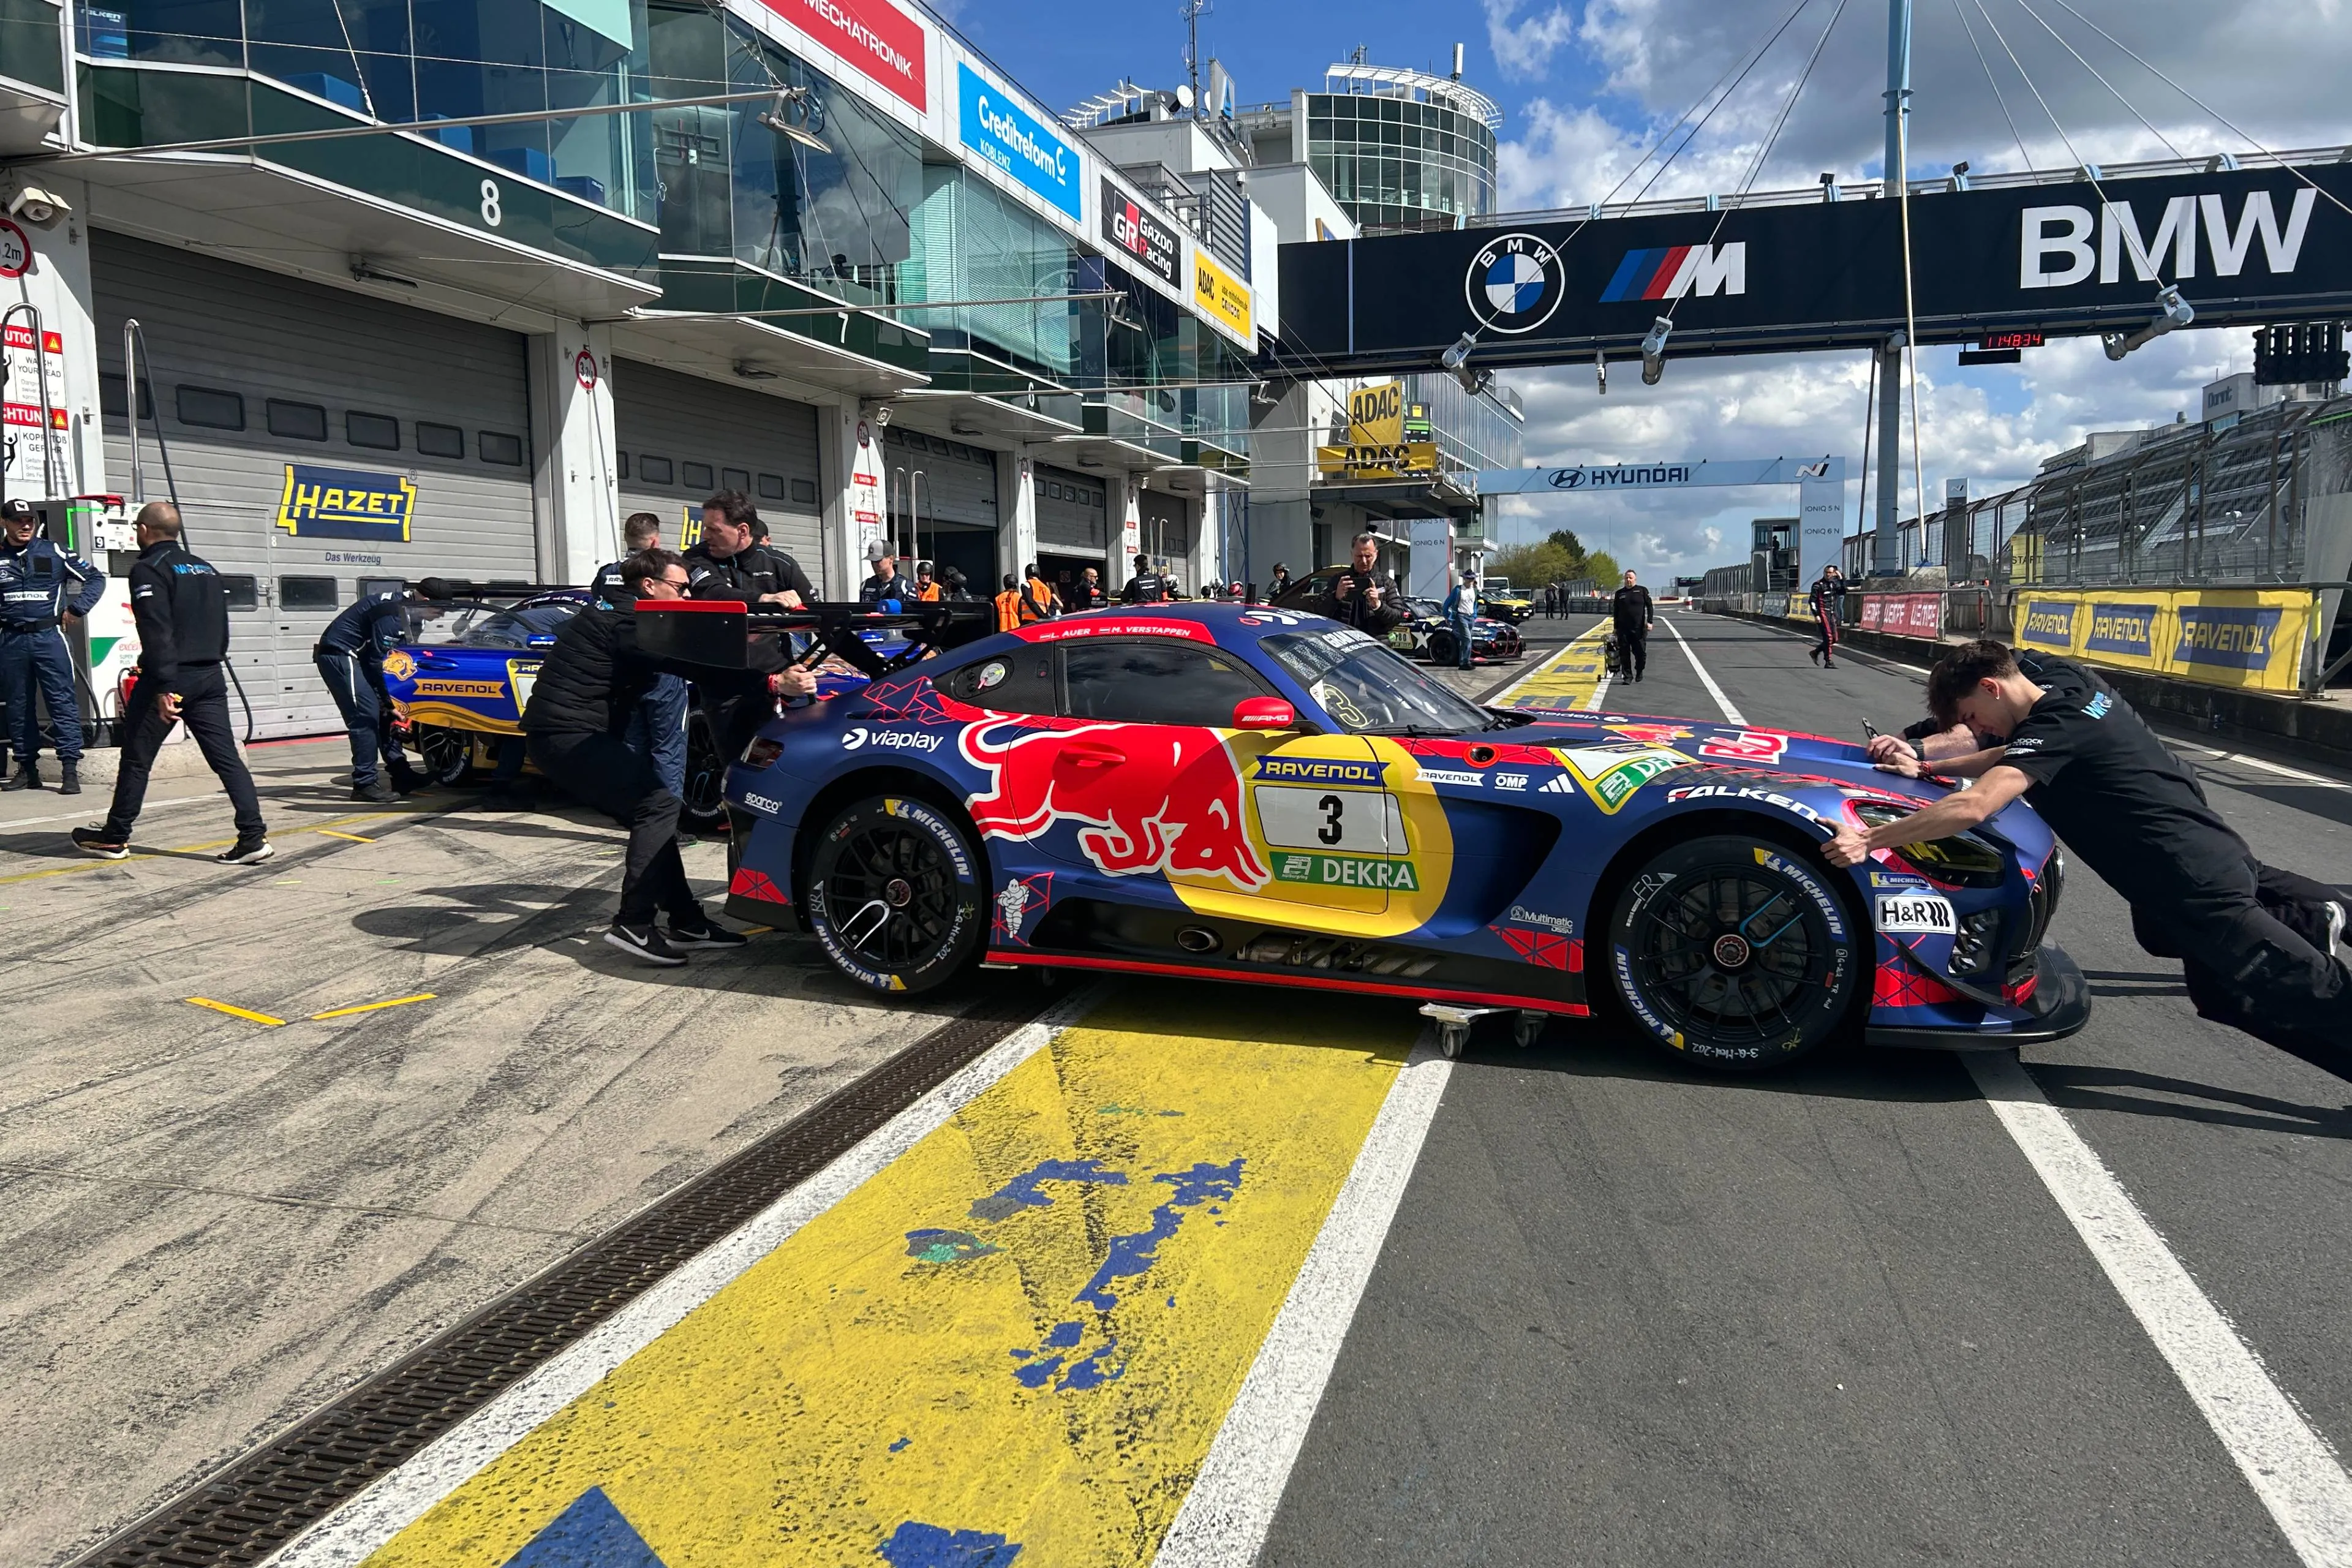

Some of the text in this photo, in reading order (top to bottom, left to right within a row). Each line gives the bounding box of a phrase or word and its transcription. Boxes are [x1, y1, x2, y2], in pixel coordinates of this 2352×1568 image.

[804, 0, 913, 80] MECHATRONIK
[979, 95, 1055, 179] Creditreform
[980, 138, 1011, 172] KOBLENZ
[481, 179, 501, 227] 8
[1114, 212, 1138, 250] GR
[1140, 216, 1173, 255] GAZOO
[2021, 188, 2317, 288] BMW
[0, 243, 21, 261] .2m
[1139, 237, 1172, 279] Racing
[1480, 239, 1551, 268] BMW
[1198, 266, 1215, 301] ADAC
[1662, 242, 1746, 300] M
[838, 312, 849, 343] 7
[1988, 334, 2041, 348] 11:48:34
[45, 369, 61, 377] EAD
[1028, 382, 1035, 407] 6
[1352, 386, 1398, 426] ADAC
[3, 409, 43, 423] CHTUN
[1145, 425, 1150, 446] 5
[1344, 445, 1410, 470] ADAC
[1592, 467, 1689, 485] HYUNDAI
[293, 484, 404, 519] HAZET
[96, 536, 104, 548] 9
[271, 536, 277, 546] 8
[325, 552, 381, 565] Das Werkzeug
[1061, 628, 1091, 638] AUER
[1126, 626, 1191, 636] VERSTAPPEN
[2027, 613, 2265, 655] RAVENOL RAVENOL RAVENOL
[422, 683, 497, 694] RAVENOL
[1323, 684, 1368, 728] 3
[872, 730, 944, 753] viaplay
[1265, 762, 1376, 780] RAVENOL
[1421, 772, 1477, 783] RAVENOL
[1494, 775, 1528, 788] OMP
[745, 792, 778, 812] sparco
[1668, 785, 1822, 823] FALKEN
[1318, 795, 1343, 845] 3
[912, 809, 970, 876] MICHELIN
[1323, 859, 1414, 889] DEKRA
[1632, 874, 1661, 900] FR
[1782, 864, 1843, 935] MICHELIN
[1881, 901, 1928, 923] H&R
[1525, 911, 1574, 927] Multimatic
[816, 925, 876, 985] MICHELIN
[1616, 951, 1659, 1028] MICHELIN
